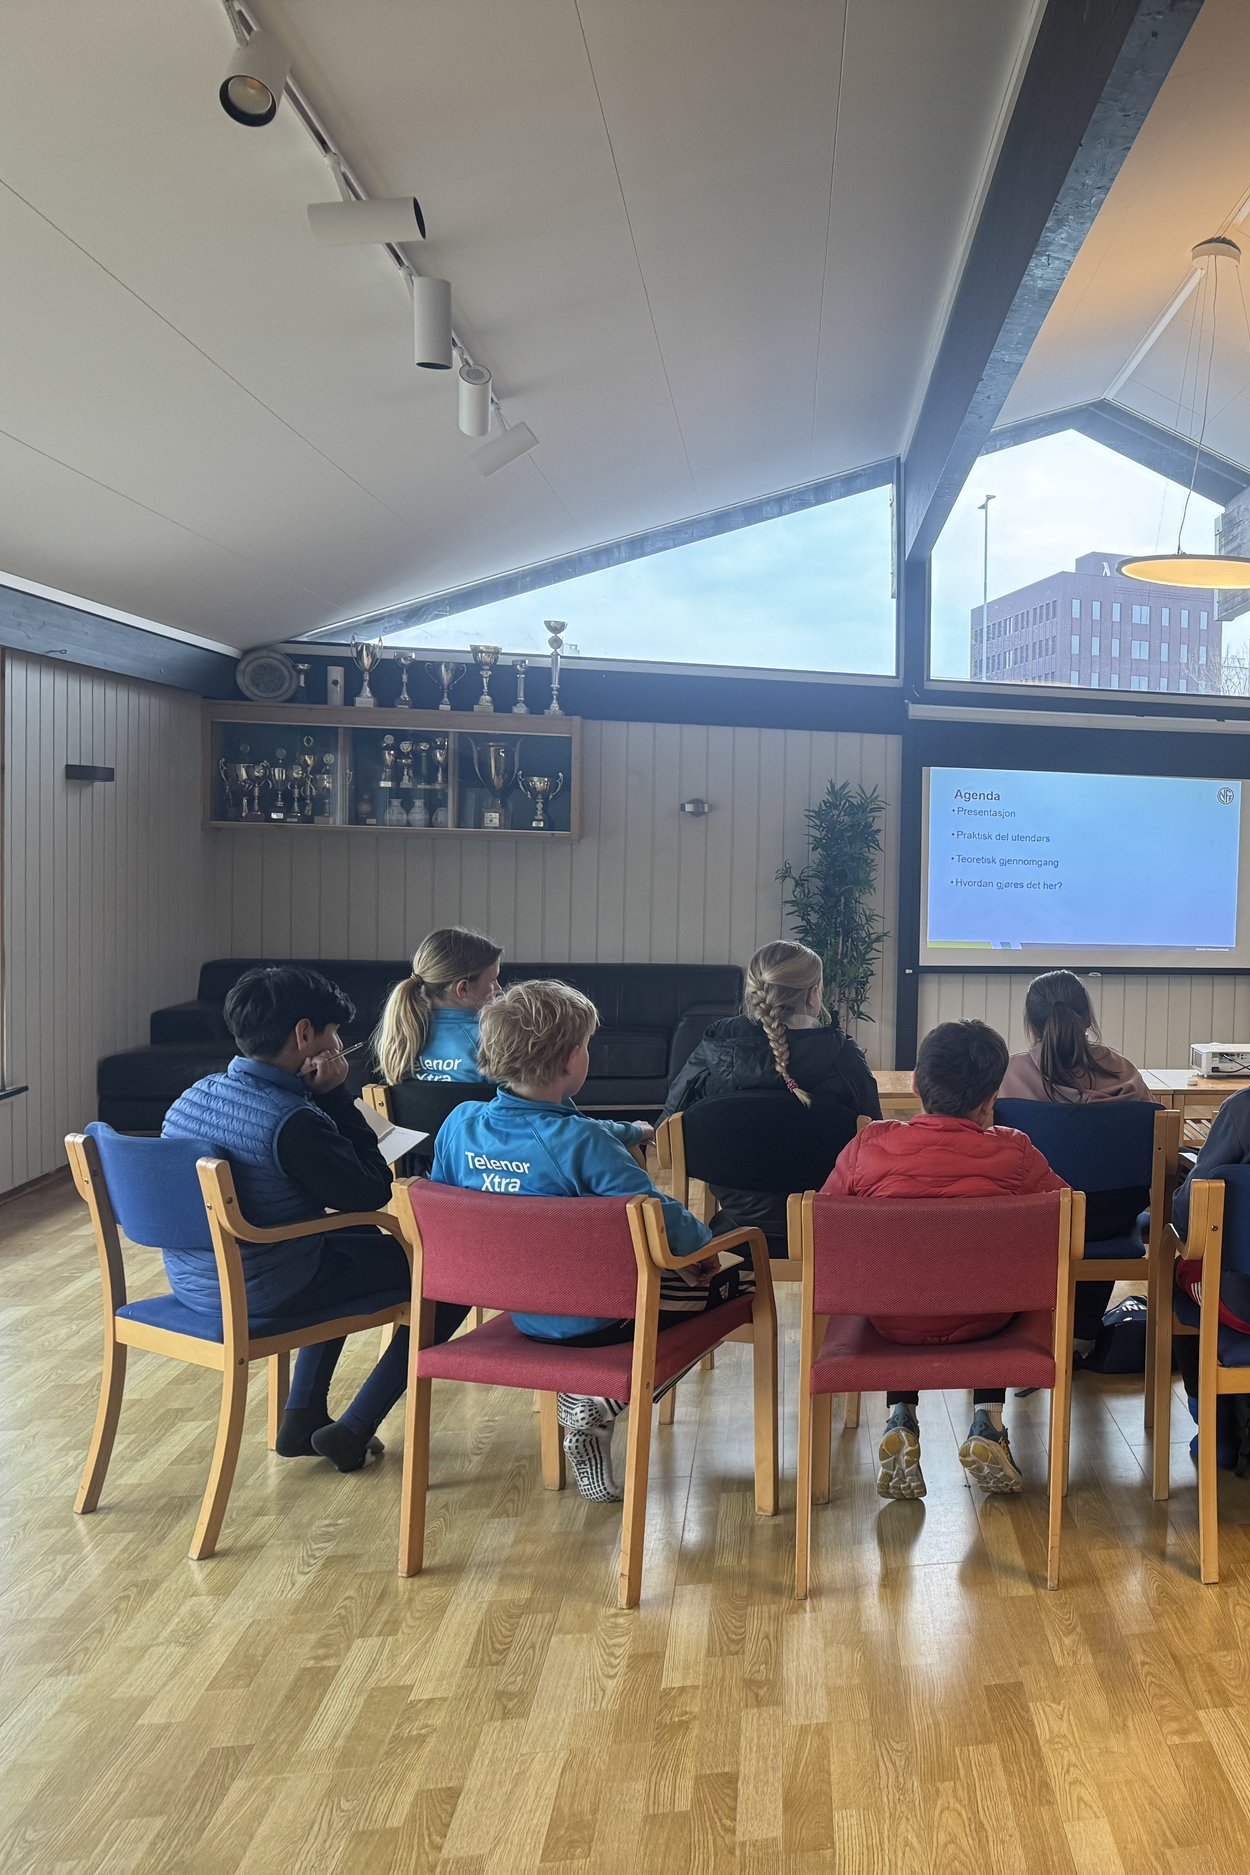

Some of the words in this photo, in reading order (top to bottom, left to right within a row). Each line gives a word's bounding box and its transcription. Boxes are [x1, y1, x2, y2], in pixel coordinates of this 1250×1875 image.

[954, 789, 1001, 802] Agenda
[956, 806, 1016, 819] Presentasjon
[956, 830, 993, 841] Praktisk
[995, 833, 1009, 841] del
[1011, 835, 1051, 843] utendørs
[956, 854, 997, 865] Teoretisk
[999, 858, 1059, 869] gjennomgang
[955, 878, 994, 888] Hvordan
[996, 880, 1024, 890] gjøres
[1026, 880, 1041, 890] det
[1043, 881, 1063, 890] her?
[414, 1056, 463, 1071] elenor
[465, 1151, 531, 1174] Telenor
[481, 1173, 521, 1192] Xtra
